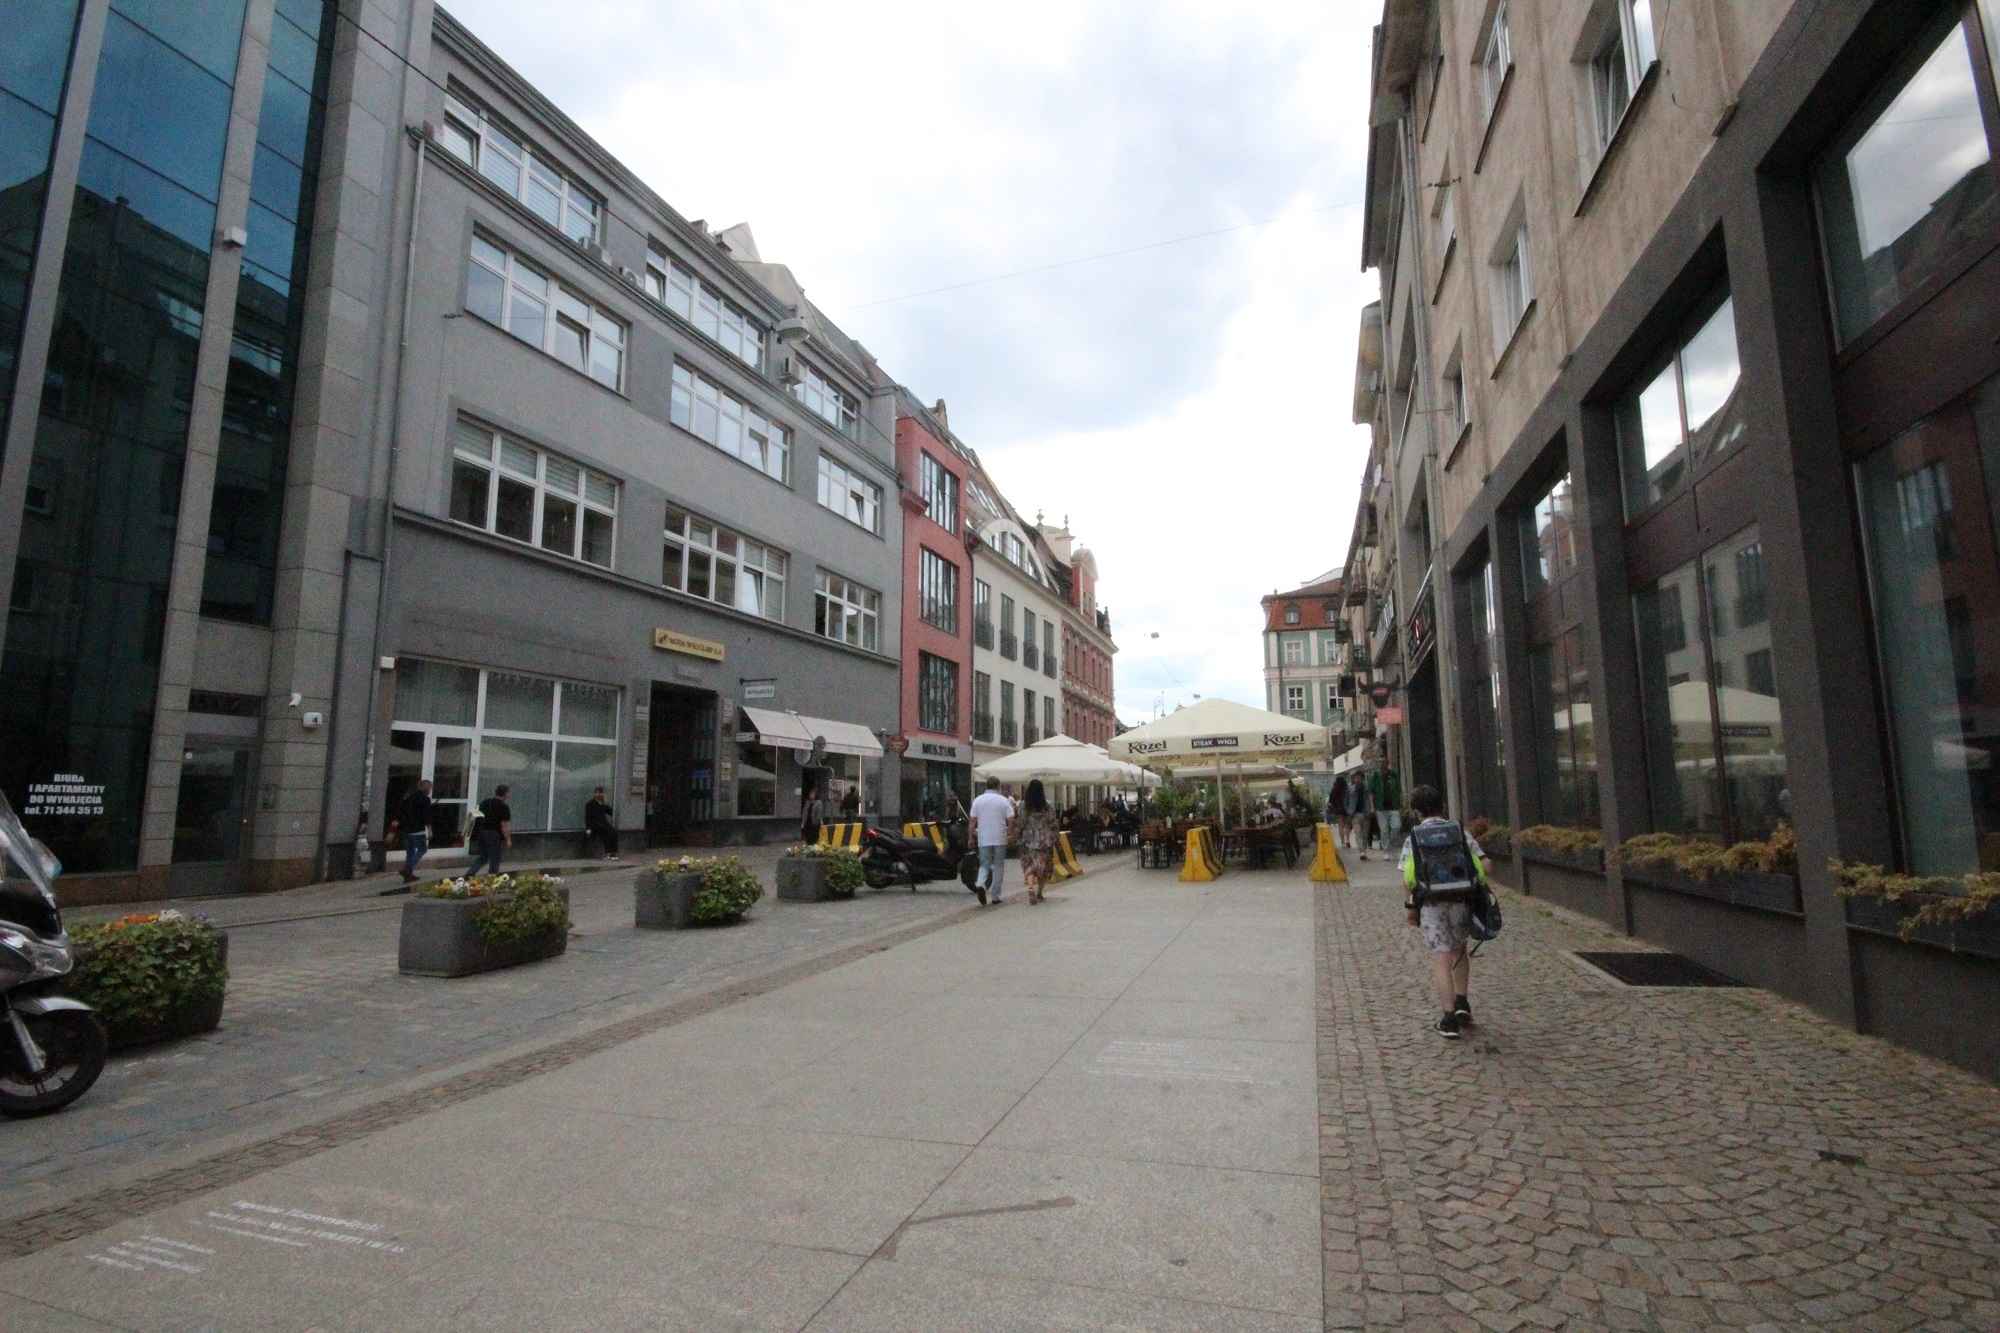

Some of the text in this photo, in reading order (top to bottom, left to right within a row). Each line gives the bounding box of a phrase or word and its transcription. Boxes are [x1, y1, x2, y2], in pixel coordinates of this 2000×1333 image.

[1264, 733, 1304, 746] Kozel
[1128, 740, 1168, 754] Kozel
[54, 773, 84, 782] BIURA
[29, 784, 105, 793] I APARTAMENTY
[30, 795, 102, 805] DO WYNAJĘCIA
[24, 806, 41, 815] tel.
[43, 806, 54, 815] 71
[56, 806, 75, 815] 344
[77, 806, 90, 815] 35
